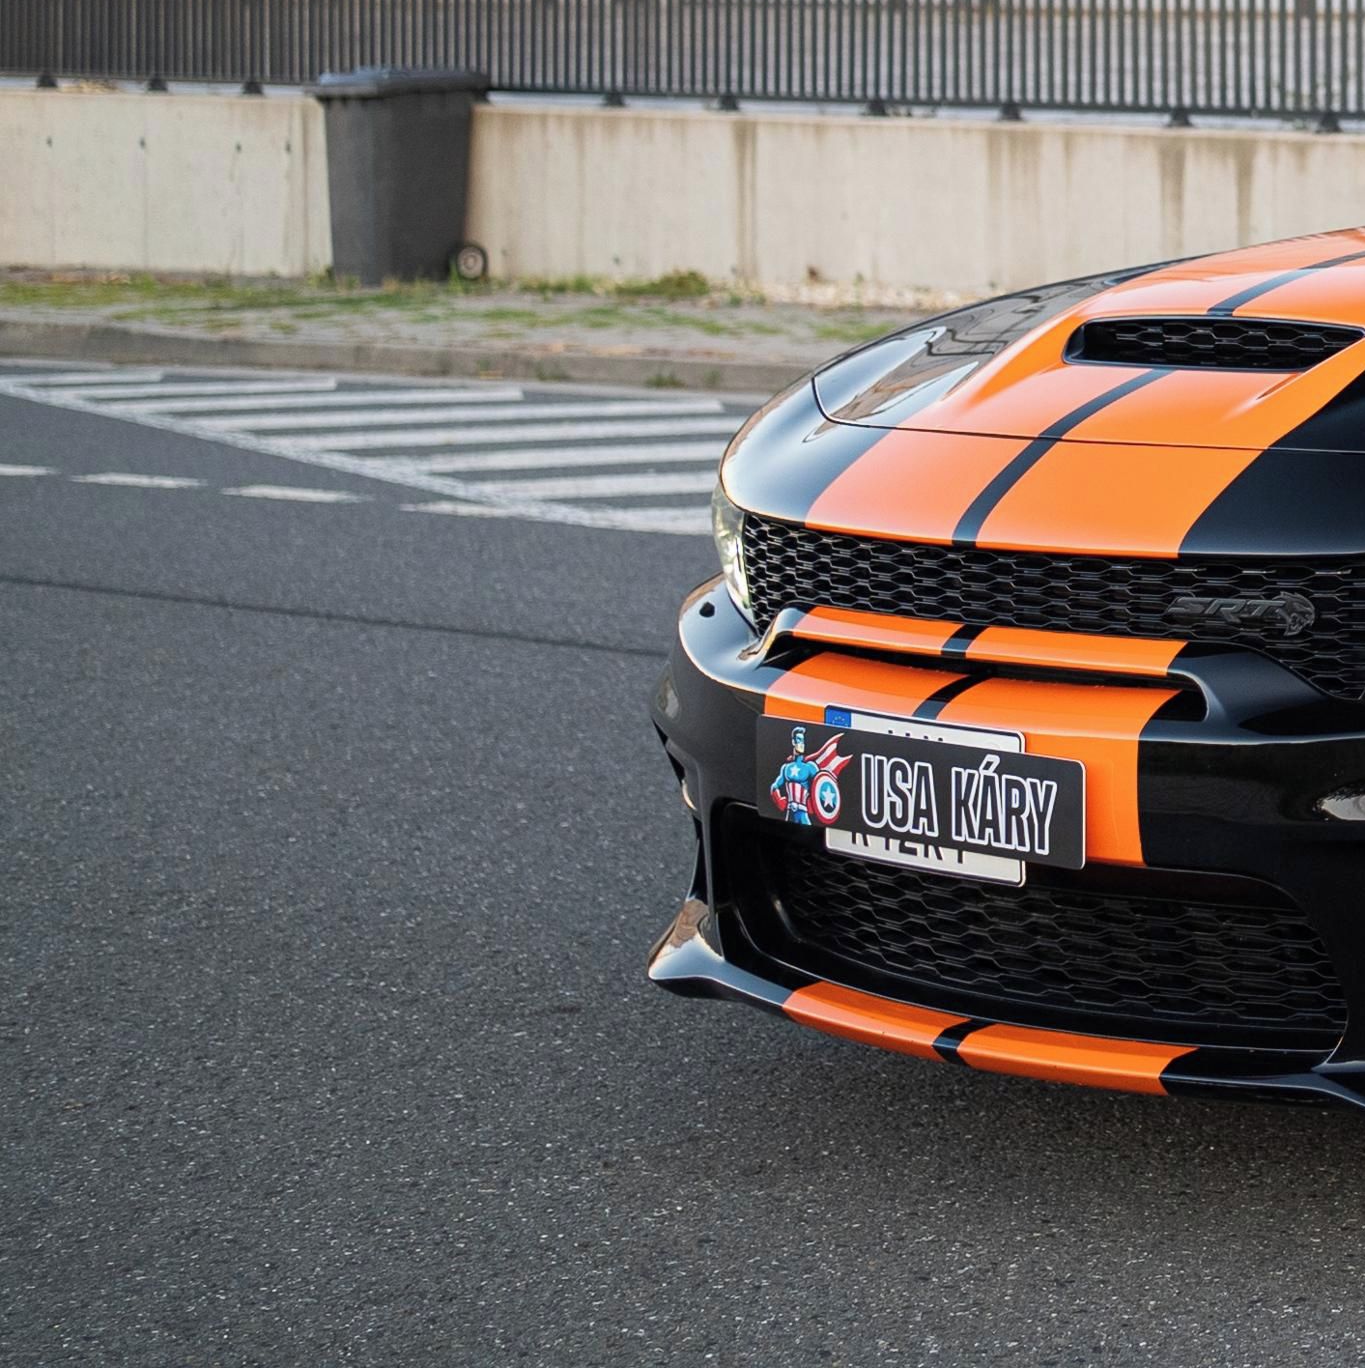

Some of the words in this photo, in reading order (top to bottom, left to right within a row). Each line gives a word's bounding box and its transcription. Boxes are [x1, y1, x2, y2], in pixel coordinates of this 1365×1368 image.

[1167, 596, 1287, 624] SRT
[861, 752, 940, 838] USA
[951, 753, 1058, 856] KÁRY
